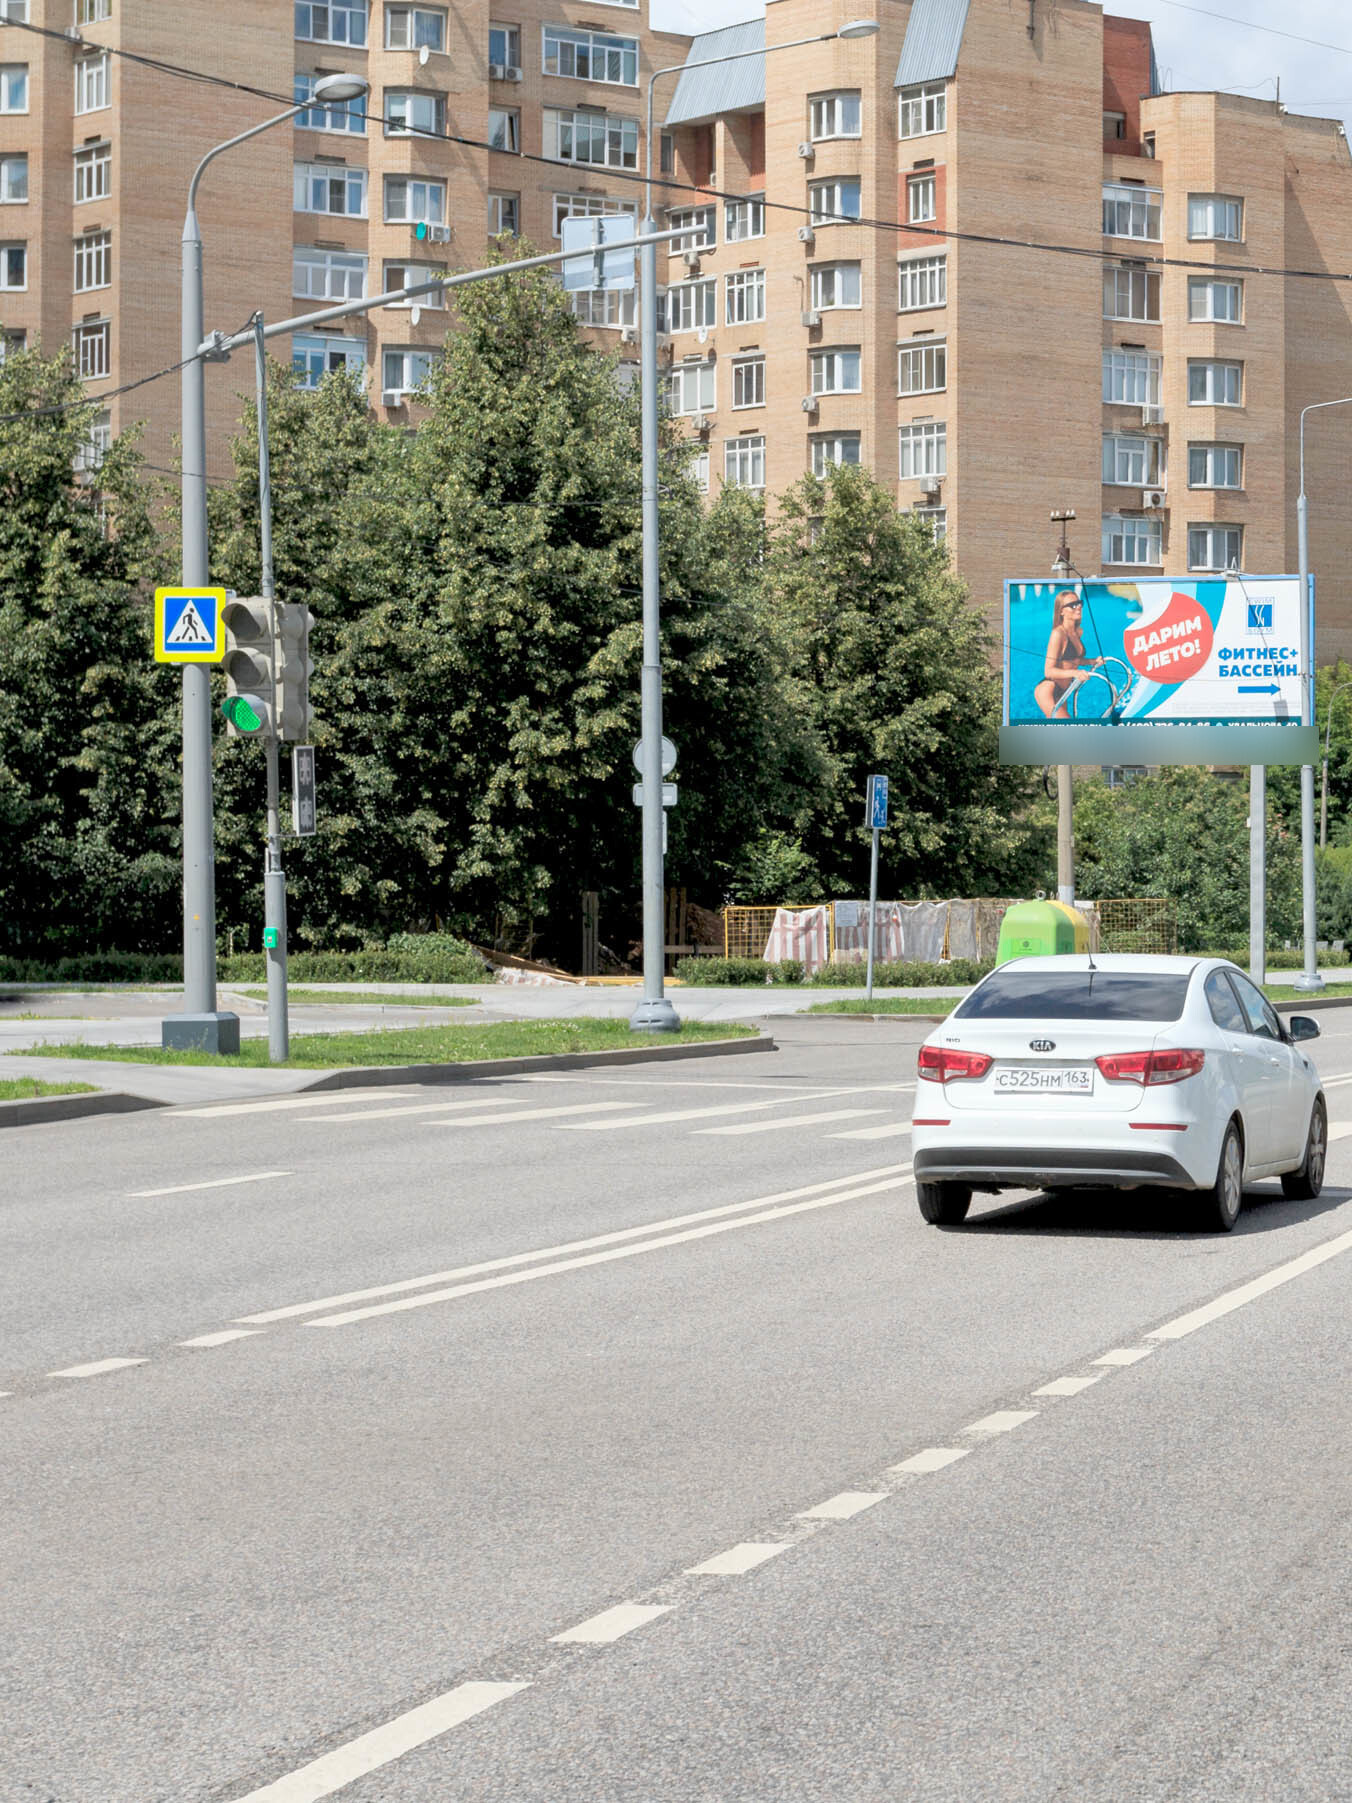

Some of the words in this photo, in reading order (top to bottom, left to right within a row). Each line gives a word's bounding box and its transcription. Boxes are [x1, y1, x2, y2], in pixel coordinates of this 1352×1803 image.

[1132, 615, 1202, 656] ДАРИМ
[1146, 638, 1201, 672] ЛЕТО!
[1217, 647, 1299, 661] ФИТНЕС+
[1218, 660, 1298, 678] БАССЕЙН
[1031, 1041, 1053, 1051] KIA
[1064, 1071, 1088, 1084] 163
